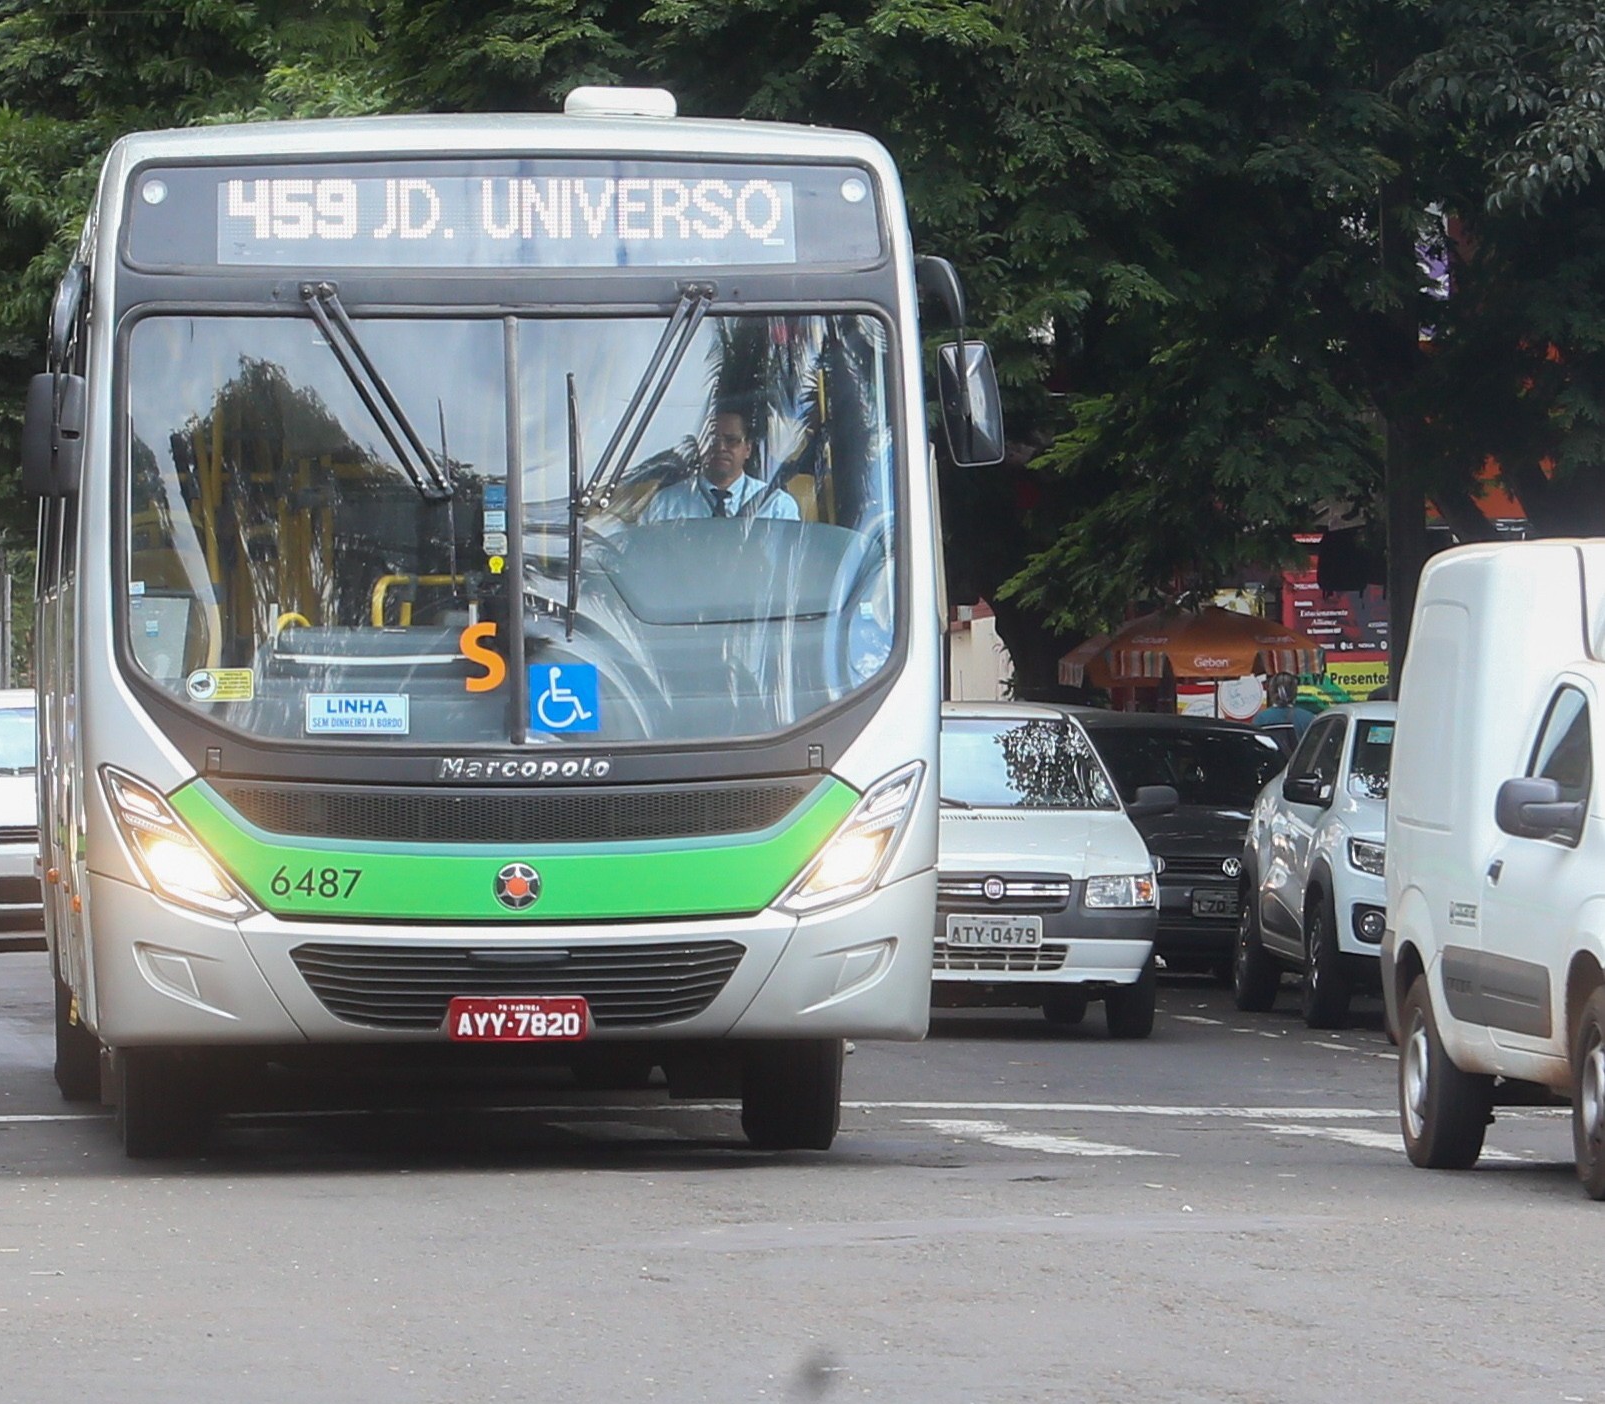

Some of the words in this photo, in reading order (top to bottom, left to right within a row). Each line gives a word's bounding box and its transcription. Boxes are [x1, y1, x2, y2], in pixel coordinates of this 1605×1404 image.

[228, 179, 356, 239] 459
[374, 179, 454, 239] JD.
[483, 179, 782, 239] UNIVERSO
[327, 700, 387, 713] LINHA
[313, 718, 329, 728] SEM
[332, 718, 367, 728] DINHEIRO
[370, 718, 374, 728] A
[377, 718, 403, 728] BORDO
[439, 758, 610, 781] Marcopolo
[270, 865, 362, 899] 6487
